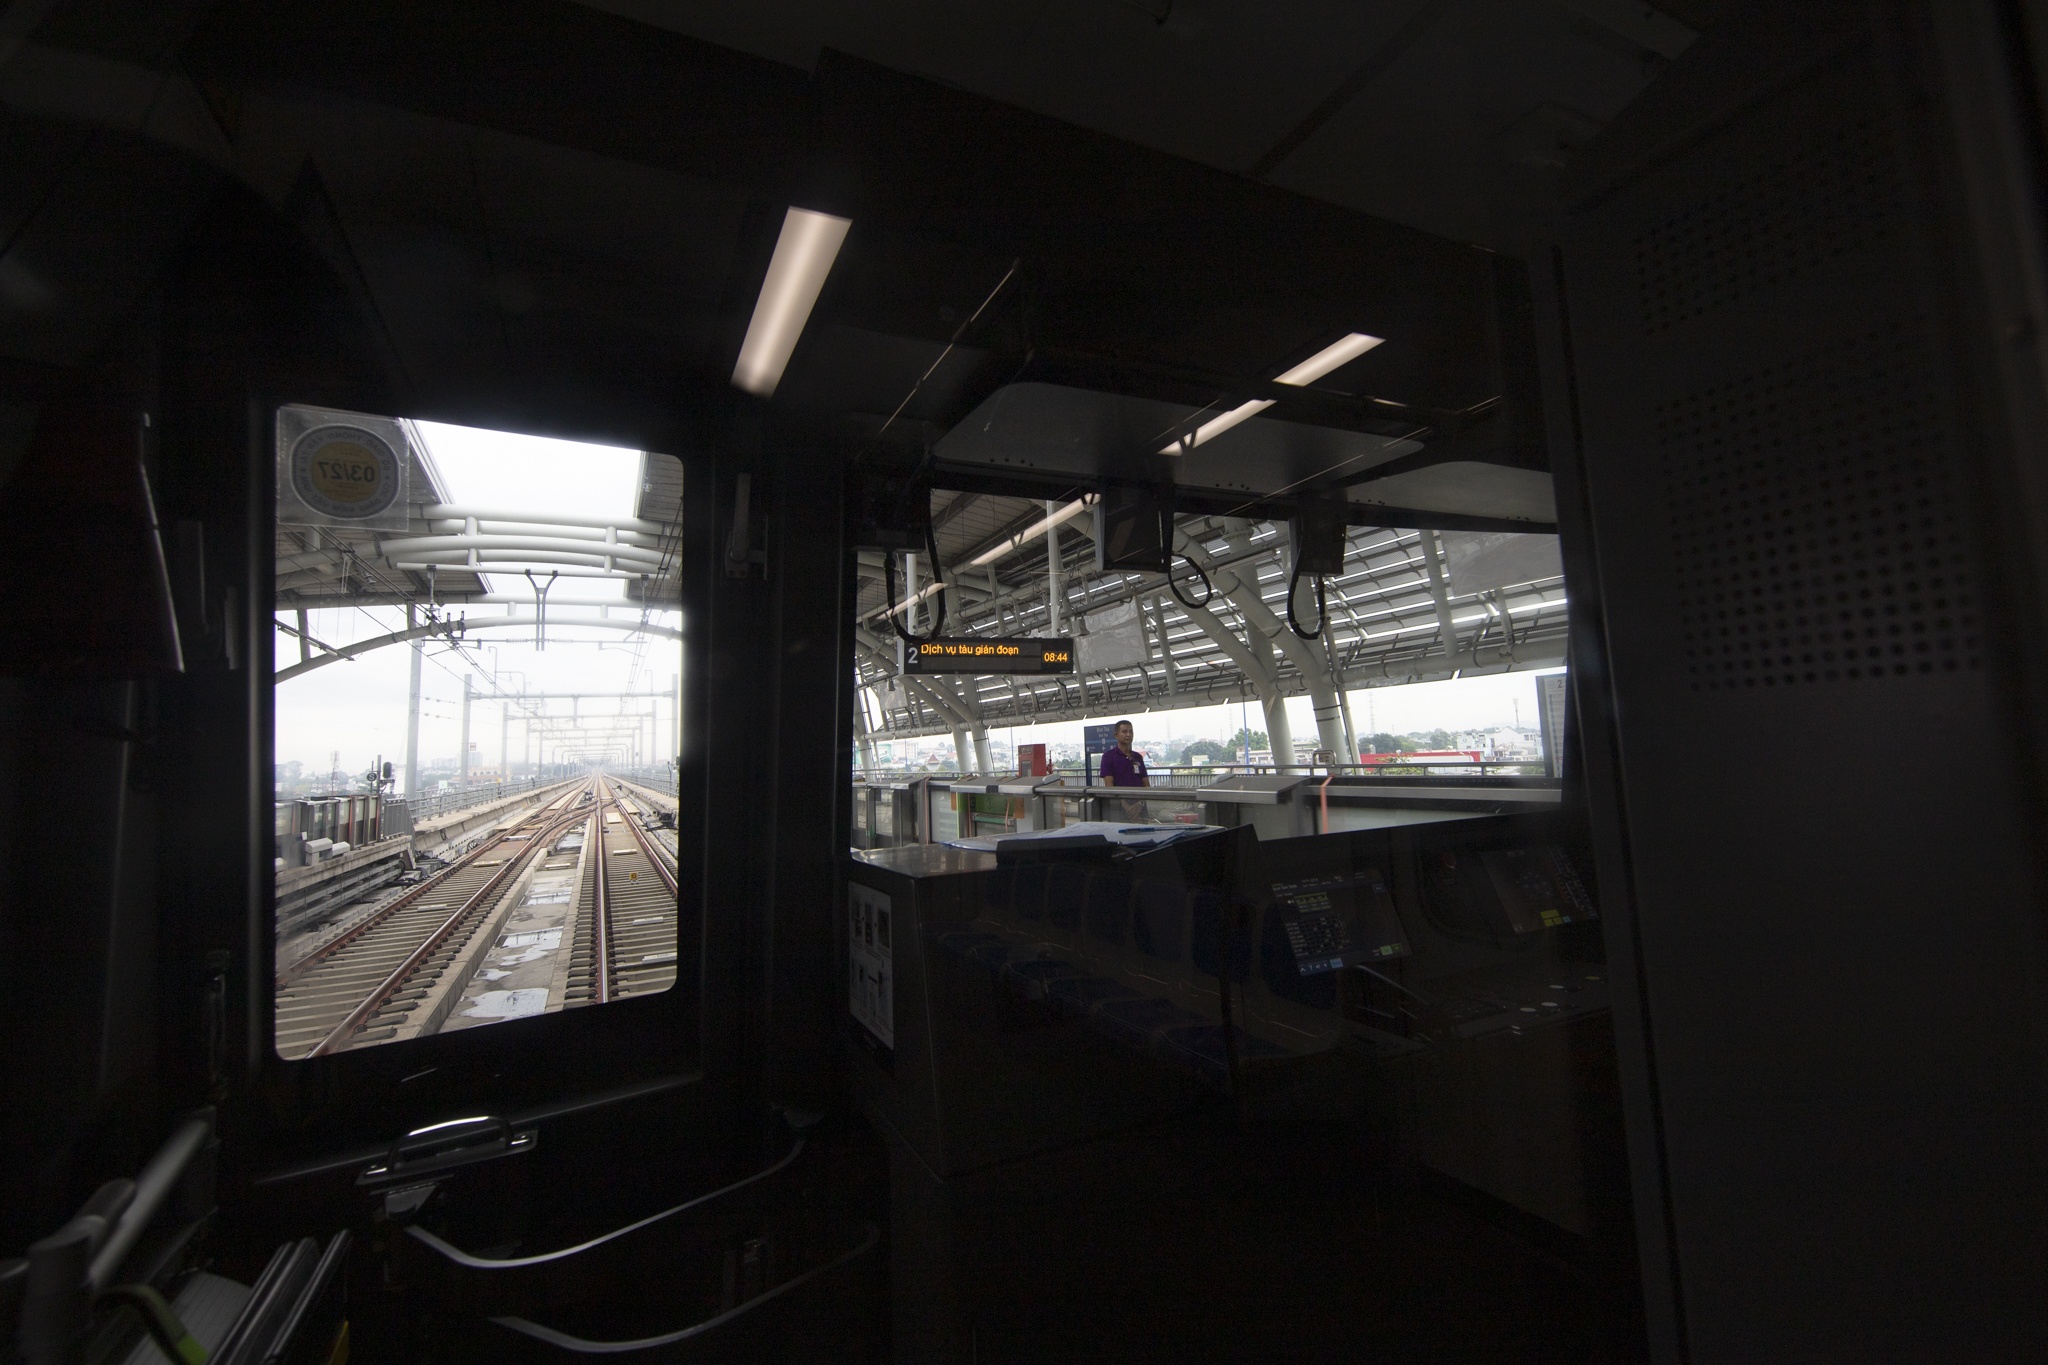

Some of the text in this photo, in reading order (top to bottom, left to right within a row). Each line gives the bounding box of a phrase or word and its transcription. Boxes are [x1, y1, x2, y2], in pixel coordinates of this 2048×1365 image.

[908, 647, 918, 664] 2
[921, 644, 1019, 656] Dịch vụ tàu gián đoạn
[1044, 652, 1068, 662] 08:44
[1557, 679, 1563, 688] 2
